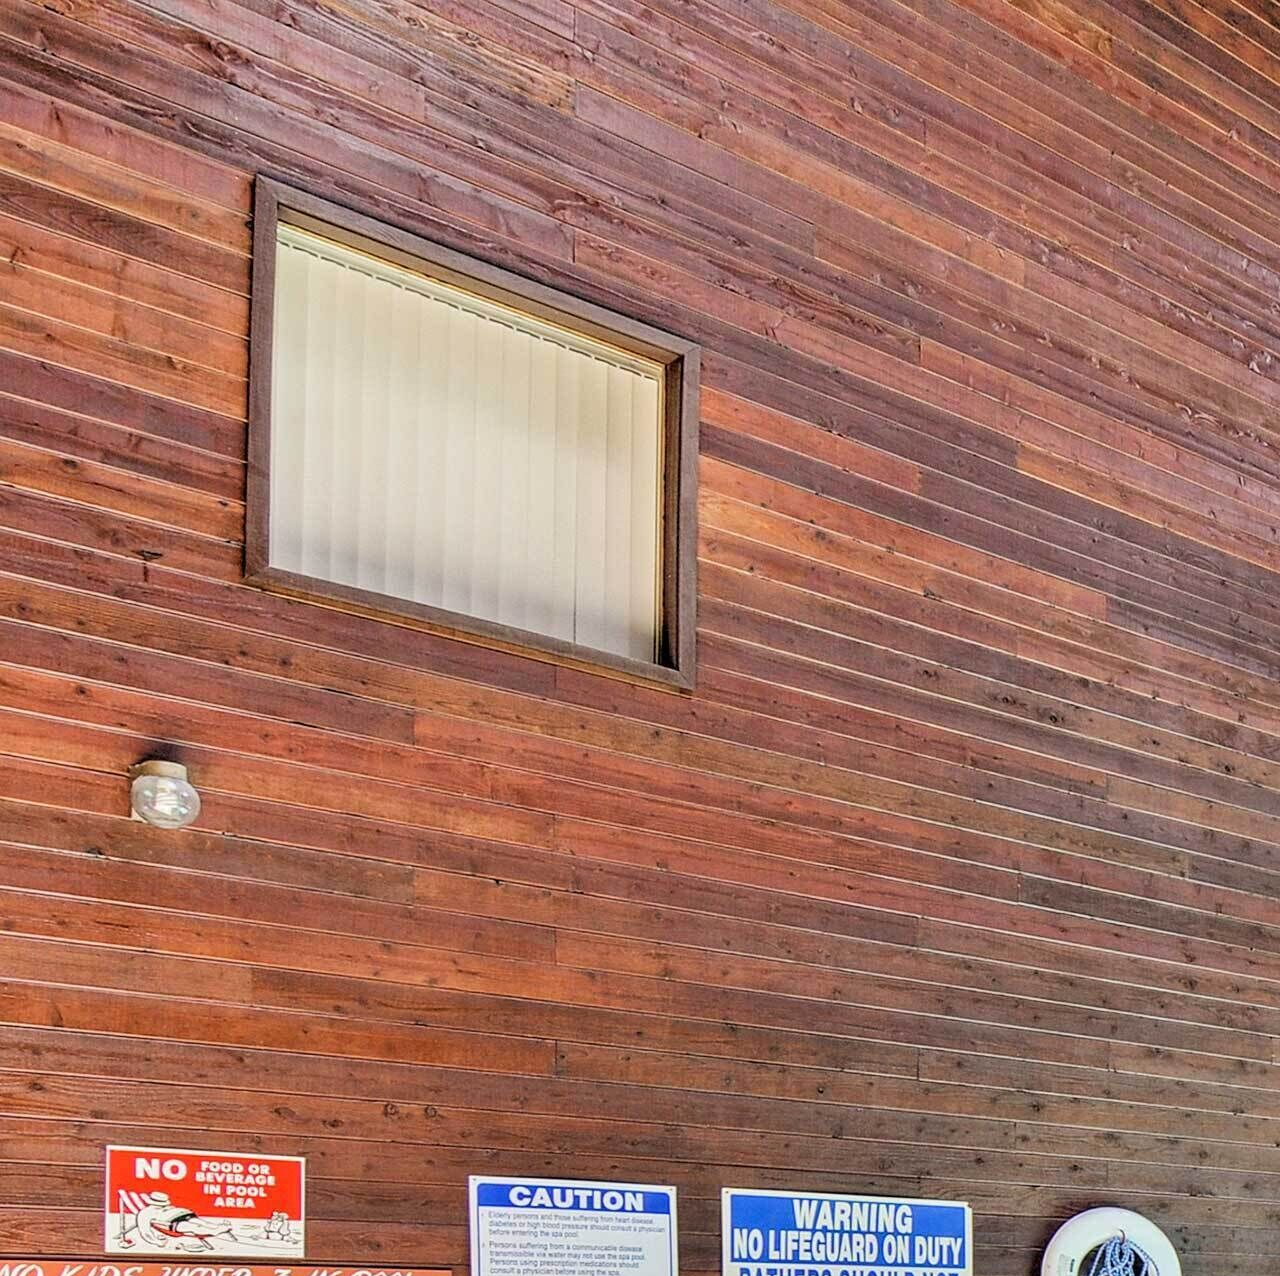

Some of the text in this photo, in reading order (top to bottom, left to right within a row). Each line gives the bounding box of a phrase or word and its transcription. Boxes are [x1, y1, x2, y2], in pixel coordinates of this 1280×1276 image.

[134, 1157, 187, 1181] NO
[201, 1161, 270, 1176] FOOD OR
[195, 1172, 276, 1186] BEVERAGE
[203, 1184, 268, 1198] IN POOL
[508, 1186, 644, 1212] CAUTION
[214, 1197, 256, 1209] AREA
[792, 1199, 912, 1234] WARNING
[733, 1228, 963, 1266] NO LIFEGUARD ON DUTY
